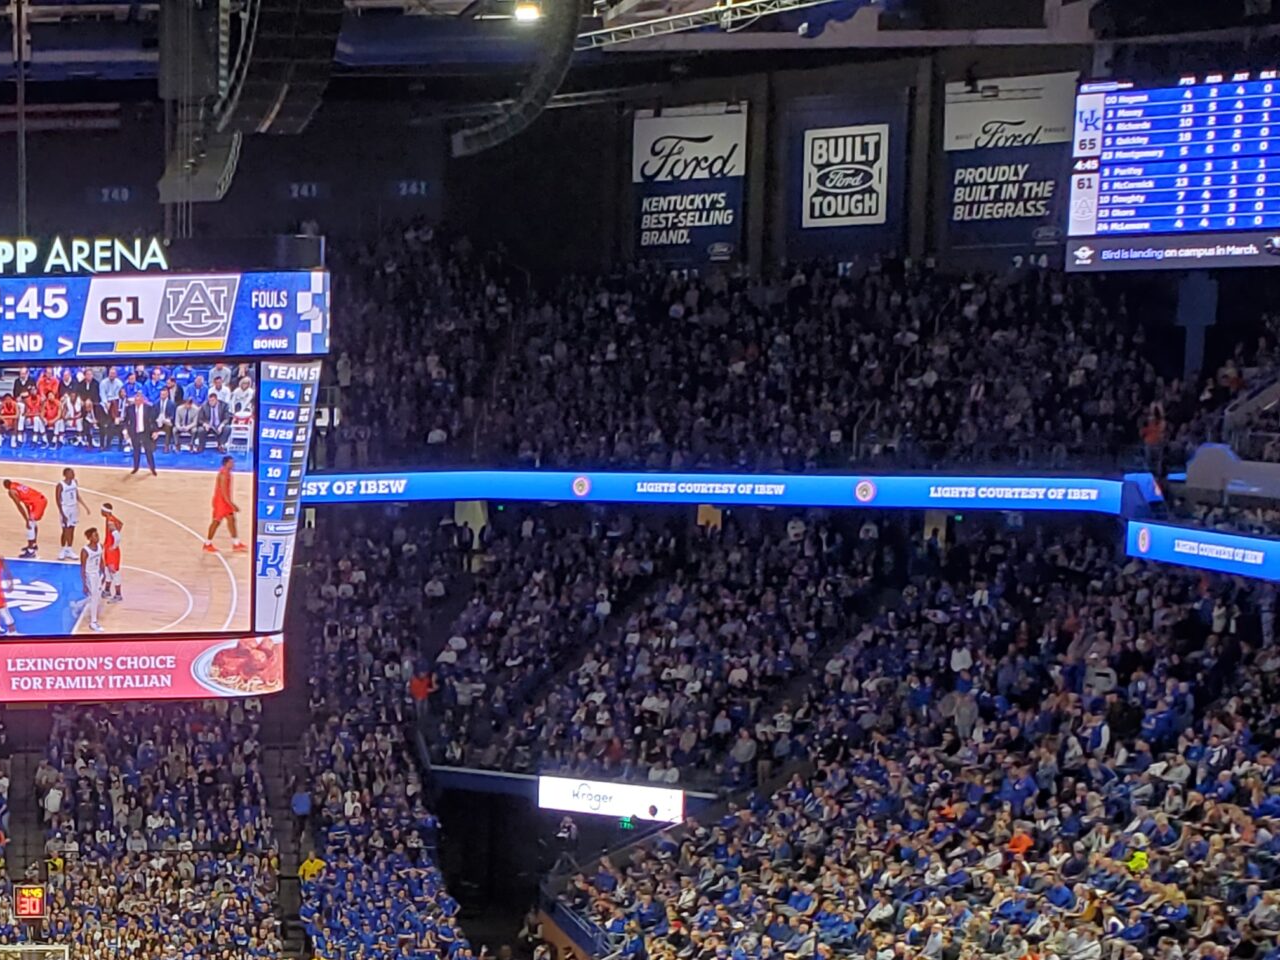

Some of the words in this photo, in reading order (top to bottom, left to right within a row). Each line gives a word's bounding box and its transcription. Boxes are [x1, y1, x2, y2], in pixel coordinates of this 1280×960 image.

[1262, 112, 1269, 121] 1
[974, 120, 1042, 149] Ford
[1233, 129, 1241, 138] 2
[1260, 128, 1269, 136] 0
[811, 134, 880, 165] BUILT
[1078, 138, 1096, 150] 65
[1232, 143, 1240, 152] 0
[1260, 142, 1268, 150] 0
[641, 134, 738, 180] Ford
[1232, 160, 1238, 170] 1
[1259, 158, 1265, 168] 1
[1074, 160, 1100, 170] 4:45
[824, 169, 864, 188] Ford
[954, 164, 1030, 185] PROUDLY
[1203, 176, 1211, 185] 2
[1230, 175, 1237, 184] 1
[1257, 174, 1266, 182] 0
[1076, 178, 1093, 189] 61
[954, 184, 998, 203] BUILT
[1000, 184, 1014, 200] IN
[1016, 181, 1055, 199] THE
[1202, 190, 1211, 199] 4
[1256, 188, 1264, 196] 0
[641, 192, 726, 210] KENTUCKY'S
[811, 192, 878, 217] TOUGH
[1255, 202, 1264, 210] 0
[952, 200, 1050, 222] BLUEGRASS.
[641, 210, 734, 229] BEST-SELLING
[1174, 220, 1183, 228] 4
[1200, 218, 1208, 226] 4
[1227, 217, 1235, 226] 0
[1254, 216, 1262, 224] 0
[640, 230, 691, 247] BRAND.
[44, 236, 168, 273] ARENA
[1102, 248, 1120, 260] Bird
[1122, 248, 1128, 258] is
[1130, 247, 1164, 260] landing
[1164, 249, 1178, 257] on
[1178, 248, 1216, 258] campus
[1226, 244, 1259, 256] March.
[252, 290, 288, 310] FOULS
[100, 296, 144, 325] 61
[258, 312, 282, 330] 10
[2, 334, 43, 353] 2ND
[253, 338, 288, 350] BONUS
[268, 365, 309, 380] TEAM
[268, 408, 295, 421] 2/10
[262, 428, 294, 440] 23/29
[269, 448, 282, 459] 31
[267, 468, 281, 478] 10
[268, 486, 276, 496] 1
[336, 480, 356, 494] OF
[360, 478, 407, 494] IBEW
[636, 481, 676, 494] LIGHTS
[678, 481, 736, 495] COURTESY
[737, 482, 752, 494] OF
[754, 484, 786, 495] IBEW
[928, 486, 976, 498] LIGHTS
[977, 486, 1046, 499] COURTESY
[1048, 487, 1064, 499] OF
[1066, 488, 1098, 500] IBEW
[266, 505, 274, 516] 7
[6, 655, 114, 672] LEXINGTON'S
[116, 654, 177, 672] CHOICE
[11, 676, 42, 692] FOR
[45, 675, 106, 690] FAMILY
[108, 674, 173, 690] ITALIAN
[572, 783, 614, 810] Kroger
[22, 888, 42, 898] 4:45
[20, 898, 41, 914] 30
